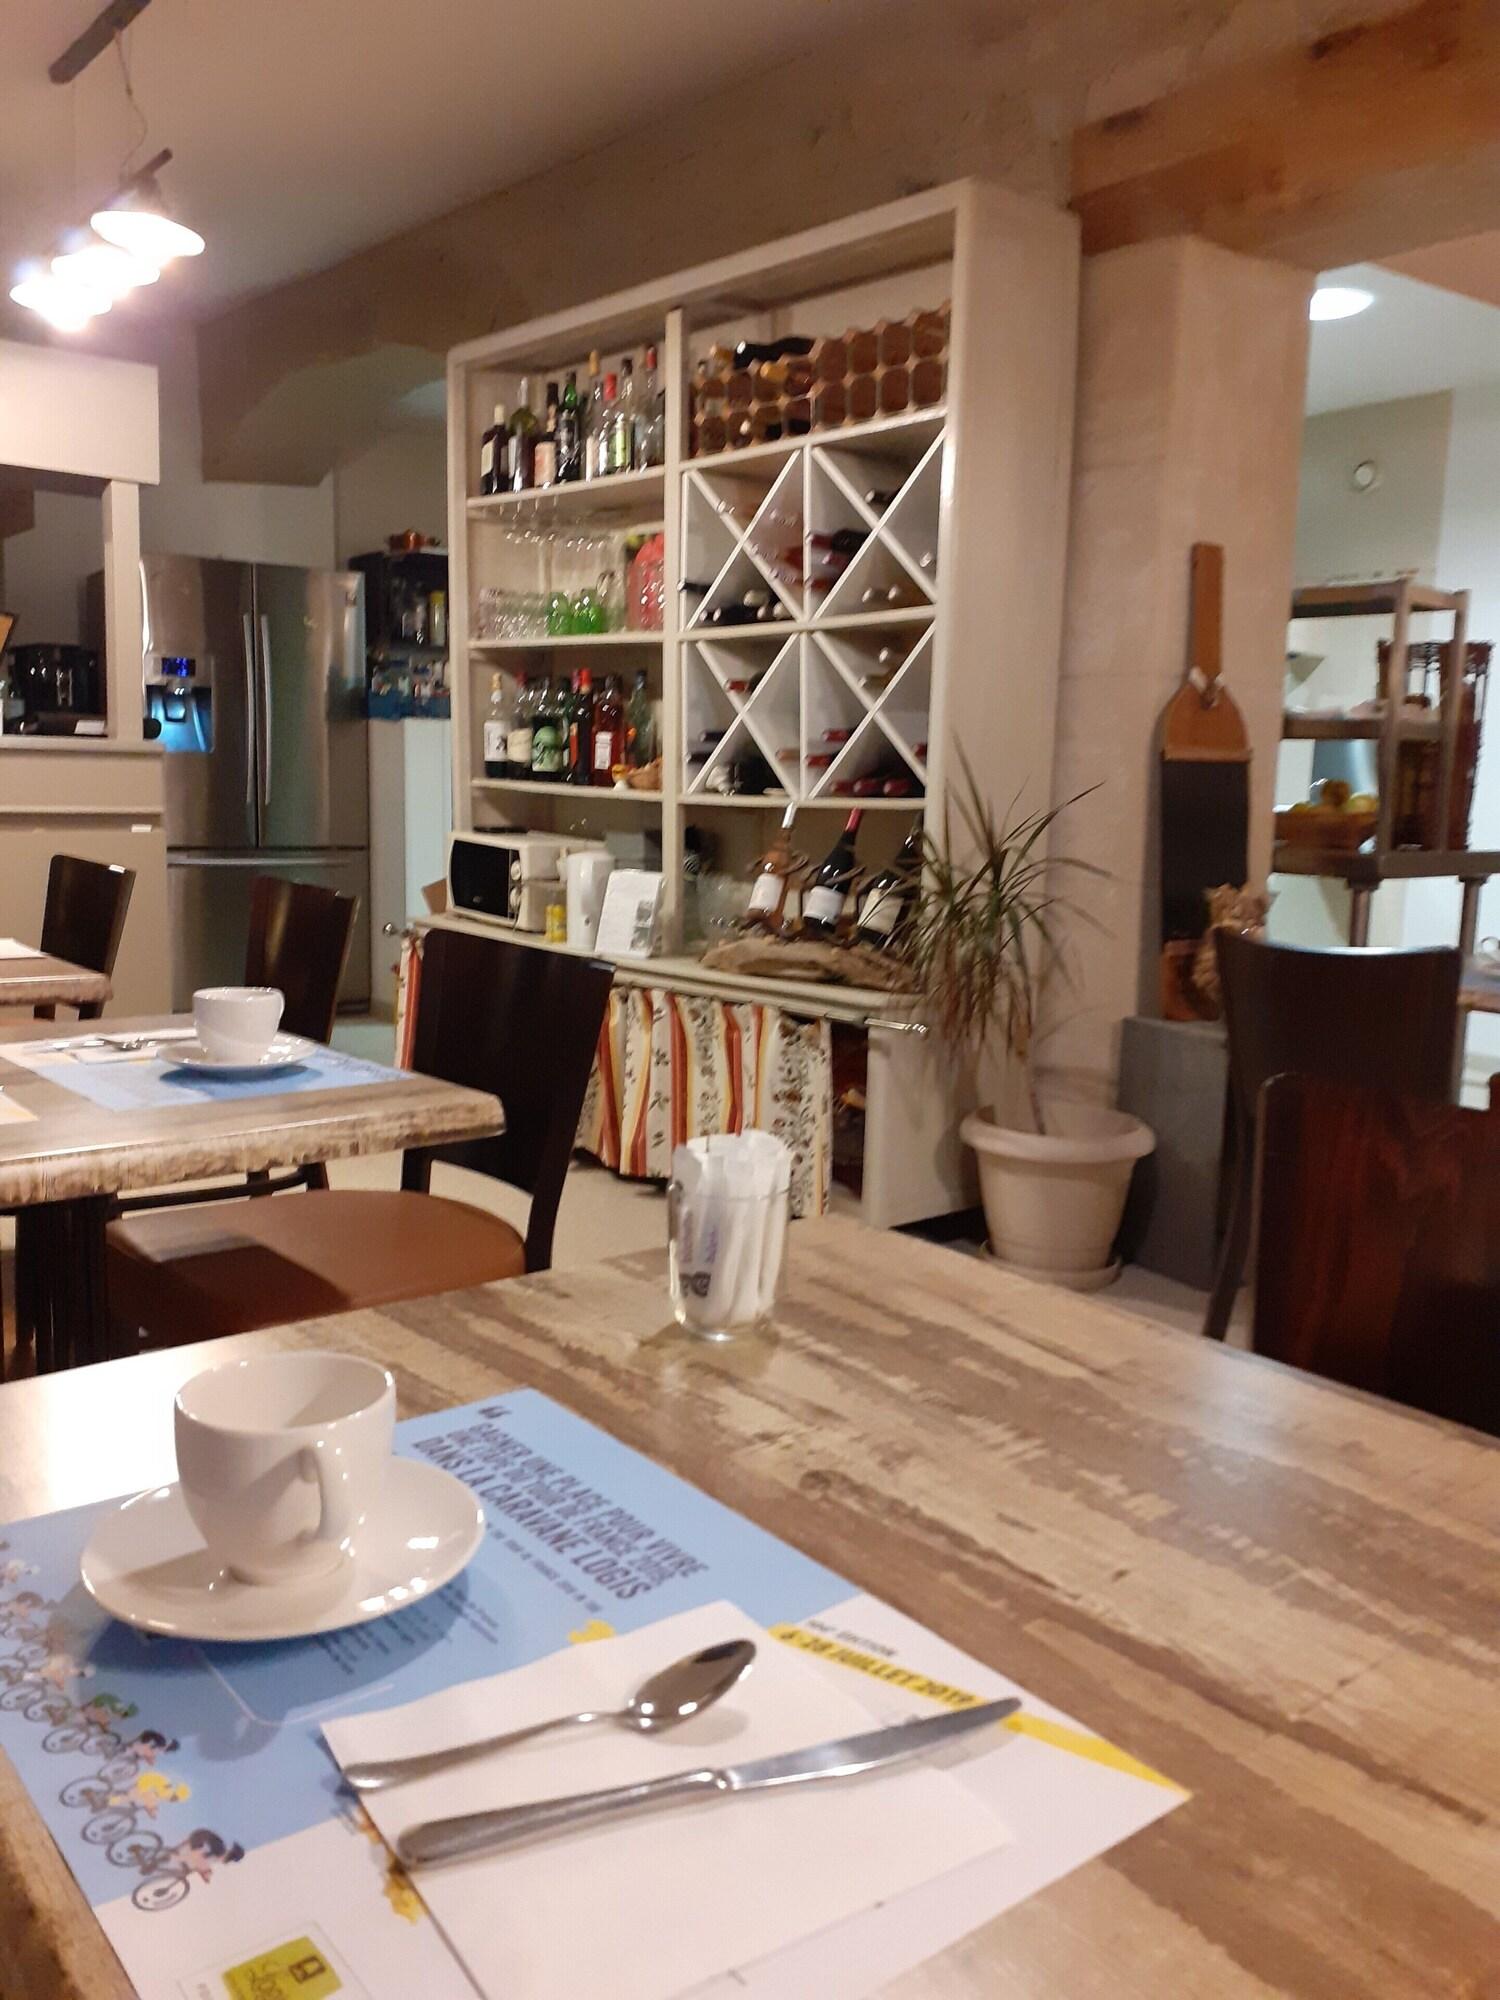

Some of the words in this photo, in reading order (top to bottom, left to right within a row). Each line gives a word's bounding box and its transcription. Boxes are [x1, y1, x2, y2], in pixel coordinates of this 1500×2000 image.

[412, 1436, 474, 1470] DANS
[456, 1466, 498, 1488] LA
[478, 1484, 590, 1554] CARAVANE
[570, 1549, 653, 1600] LOGIS
[596, 1507, 655, 1542] POUR
[645, 1538, 709, 1577] VIVRE
